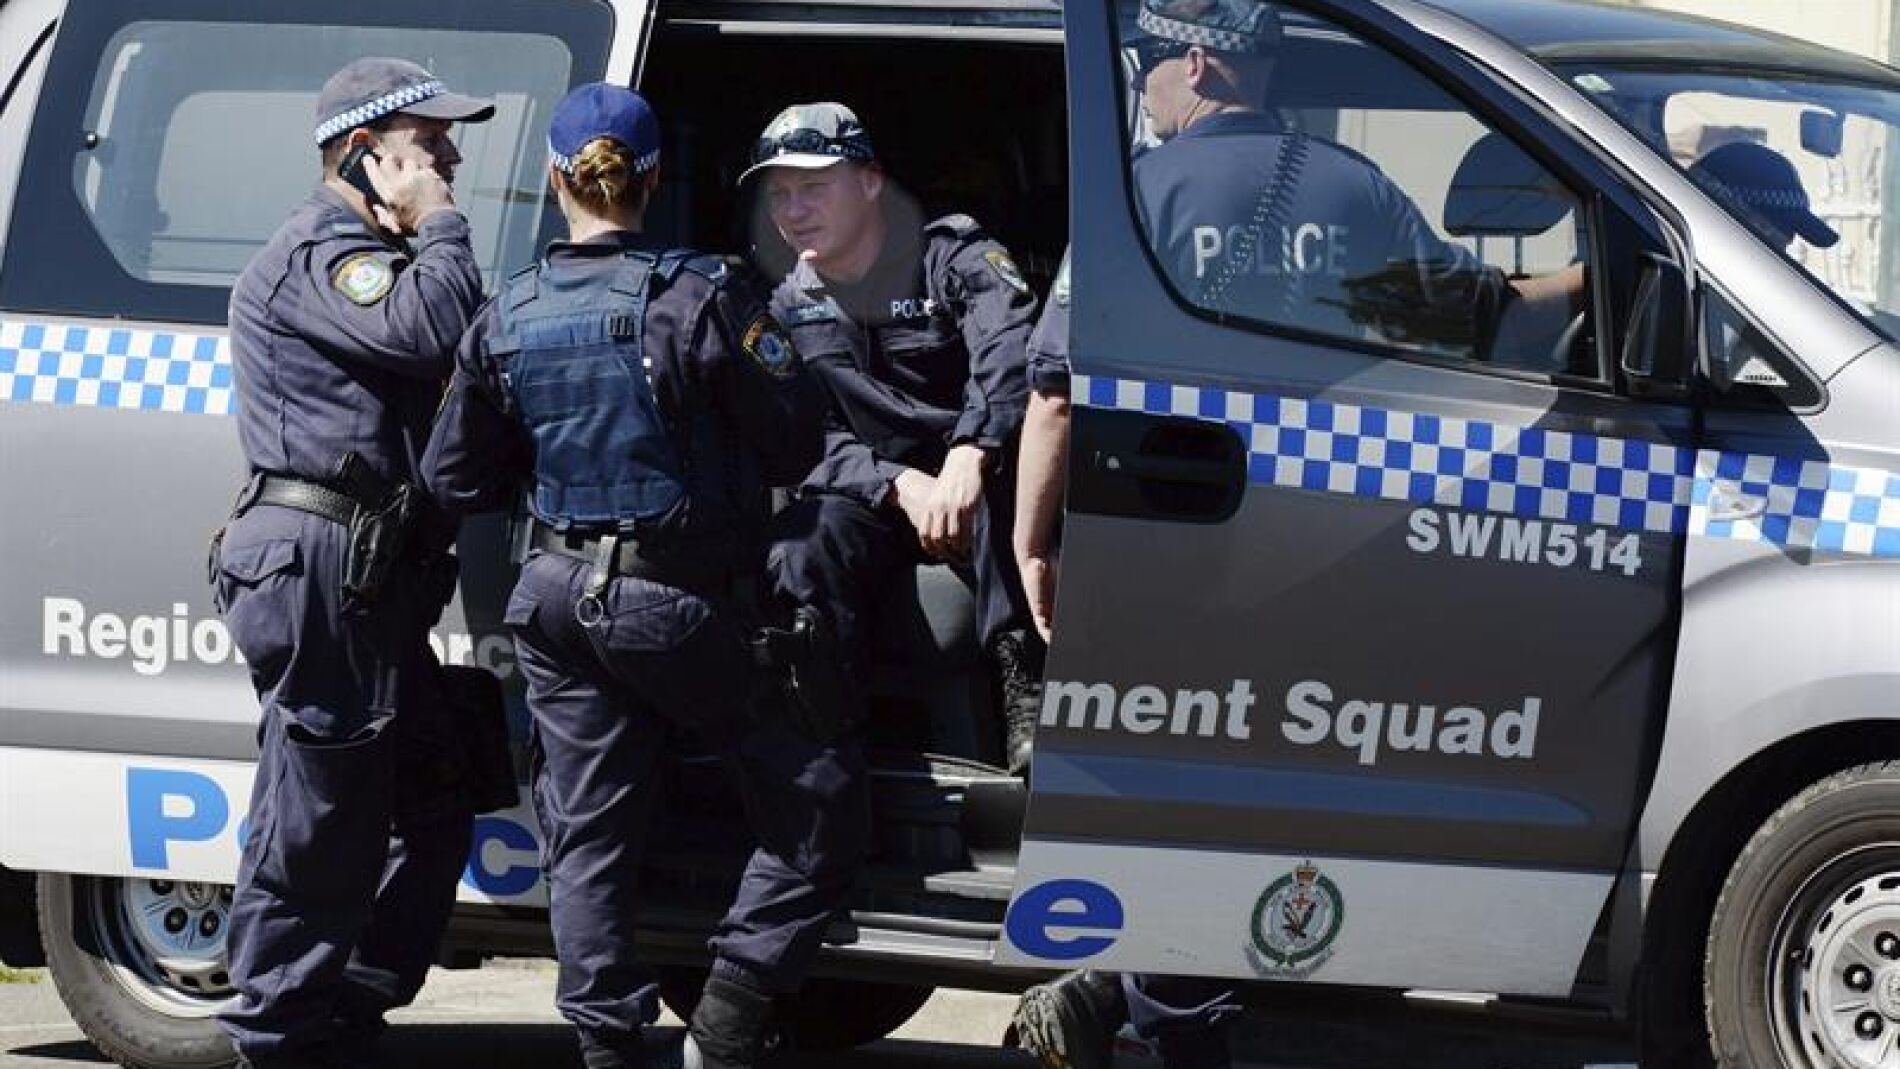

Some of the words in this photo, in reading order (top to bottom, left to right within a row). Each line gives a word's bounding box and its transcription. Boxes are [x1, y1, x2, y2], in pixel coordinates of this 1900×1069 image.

[1194, 223, 1350, 278] POLICE
[1406, 508, 1642, 576] SWM514
[43, 598, 248, 674] Regio
[1040, 679, 1254, 740] ment
[1280, 680, 1542, 765] Squad
